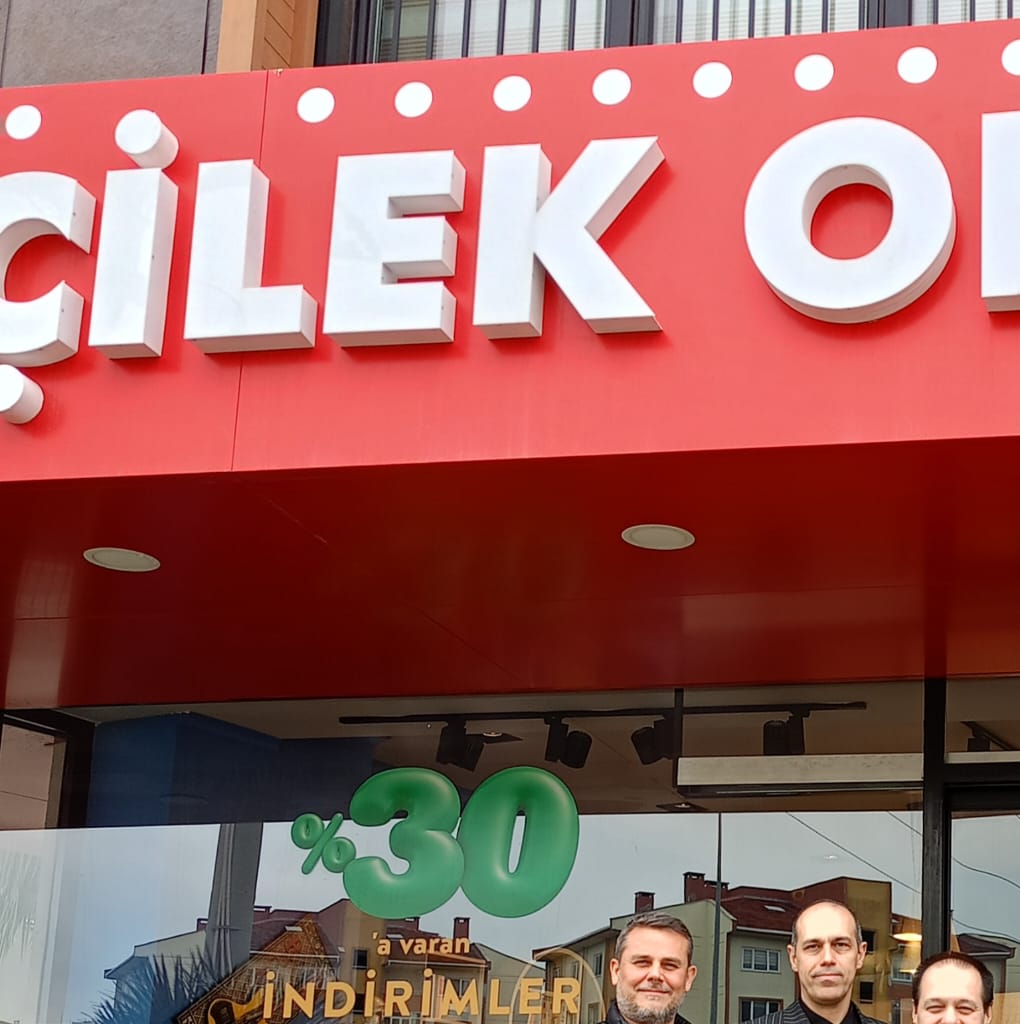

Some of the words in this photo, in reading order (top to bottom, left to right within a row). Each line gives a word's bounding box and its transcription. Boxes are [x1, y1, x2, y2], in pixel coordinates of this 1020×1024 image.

[0, 109, 665, 424] ÇİLEK
[291, 766, 580, 920] %30
[262, 968, 582, 1019] İNDİRİMLER
[400, 935, 471, 956] varan
